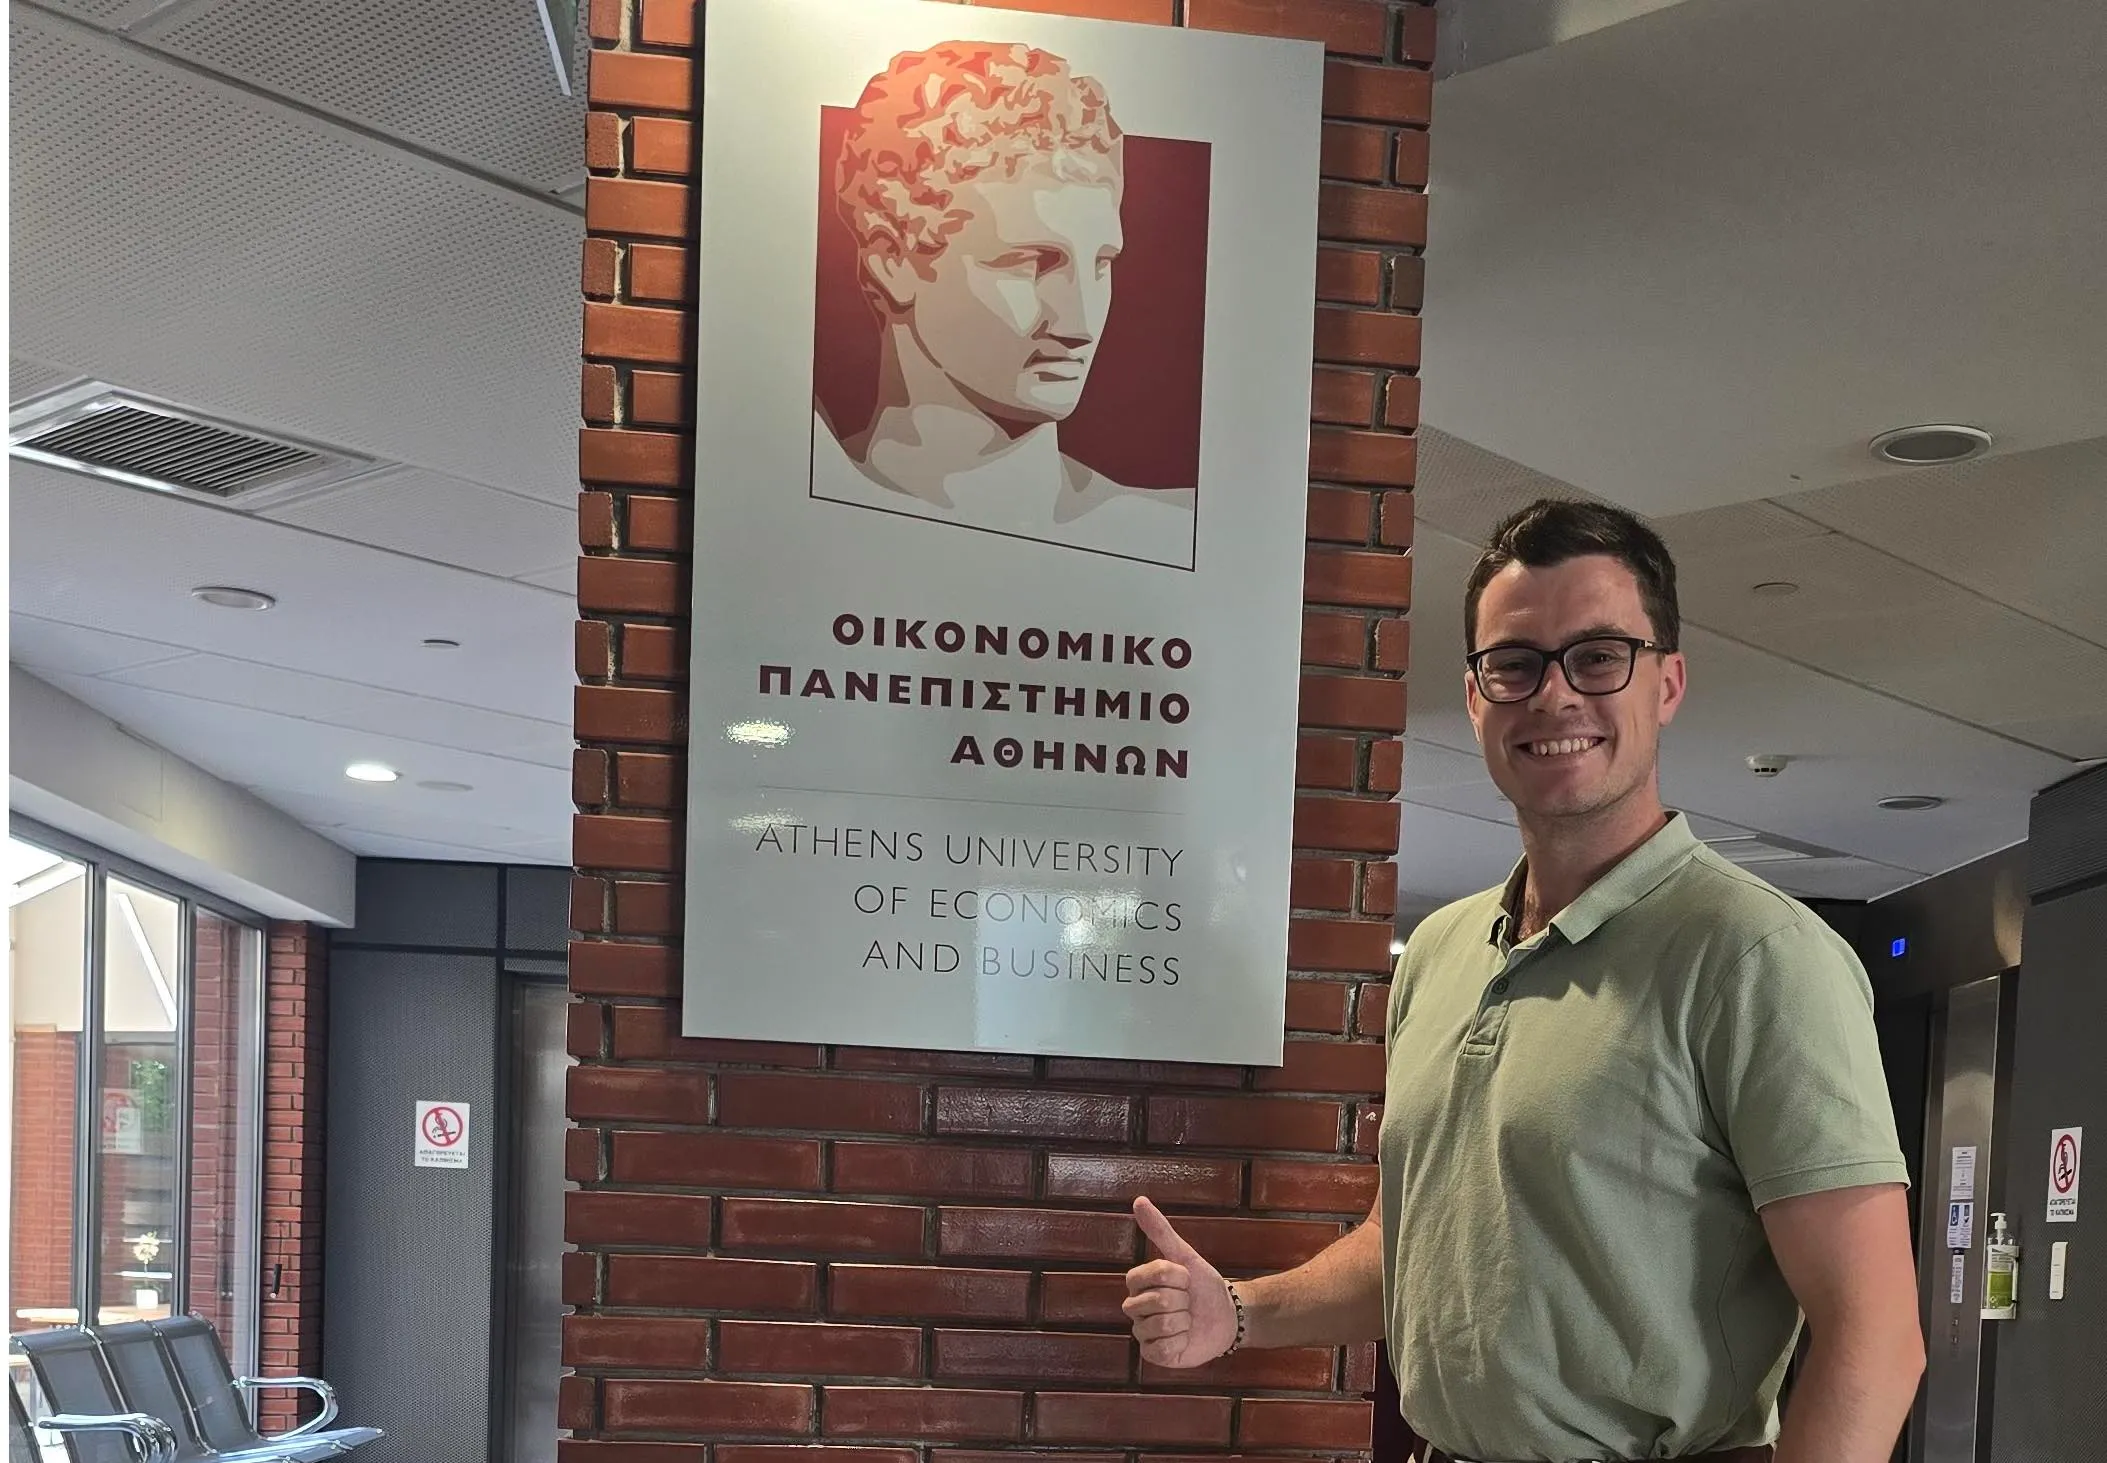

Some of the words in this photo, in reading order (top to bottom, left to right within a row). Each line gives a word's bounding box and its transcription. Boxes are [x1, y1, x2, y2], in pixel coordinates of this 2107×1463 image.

[832, 613, 1192, 670] ΟΙΚΟΝΟΜΙΚΟ
[759, 664, 1190, 725] ΠΑΝΕΠΙΣΤΗΜΙΟ
[949, 735, 1189, 779] ΑΘΗΝΩΝ
[755, 822, 924, 863] ATHENS
[946, 834, 1184, 878] UNIVERSITY
[854, 884, 909, 915] OF
[930, 888, 1182, 932] ECONOMICS
[861, 939, 960, 973] AND
[982, 946, 1180, 986] BUSINESS
